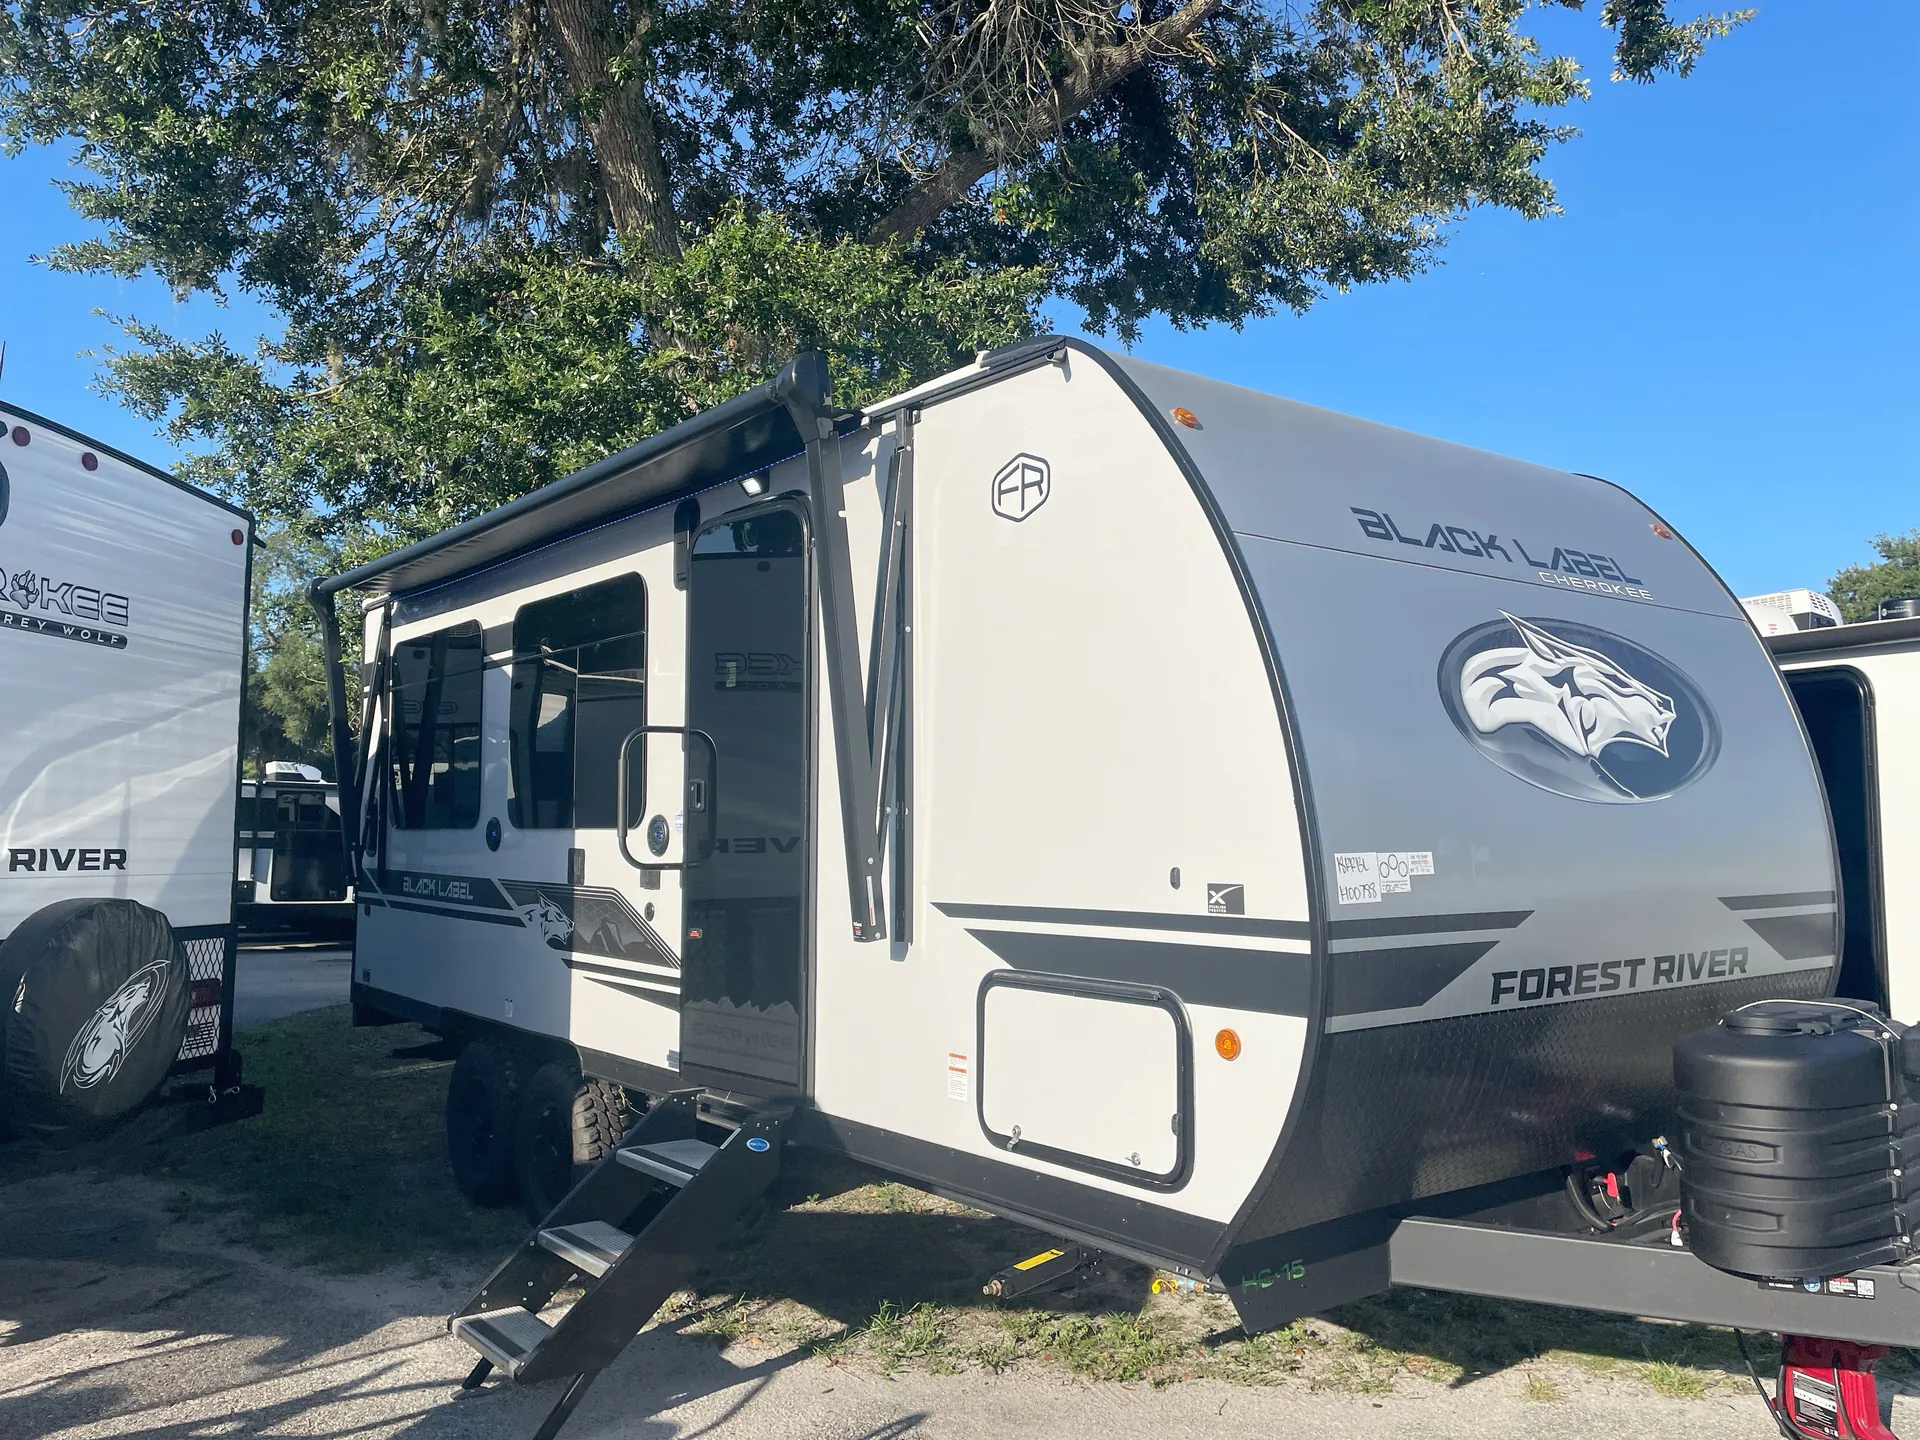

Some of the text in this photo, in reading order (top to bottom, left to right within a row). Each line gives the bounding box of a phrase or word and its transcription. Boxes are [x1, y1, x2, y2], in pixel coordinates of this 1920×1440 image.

[1350, 506, 1644, 586] BLACK LABEL
[1538, 571, 1655, 602] CHEROKEE
[62, 625, 120, 645] WOLF
[7, 848, 127, 872] RIVER
[402, 876, 474, 900] BLACK LABEL
[1490, 946, 1750, 1006] FOREST RIVER
